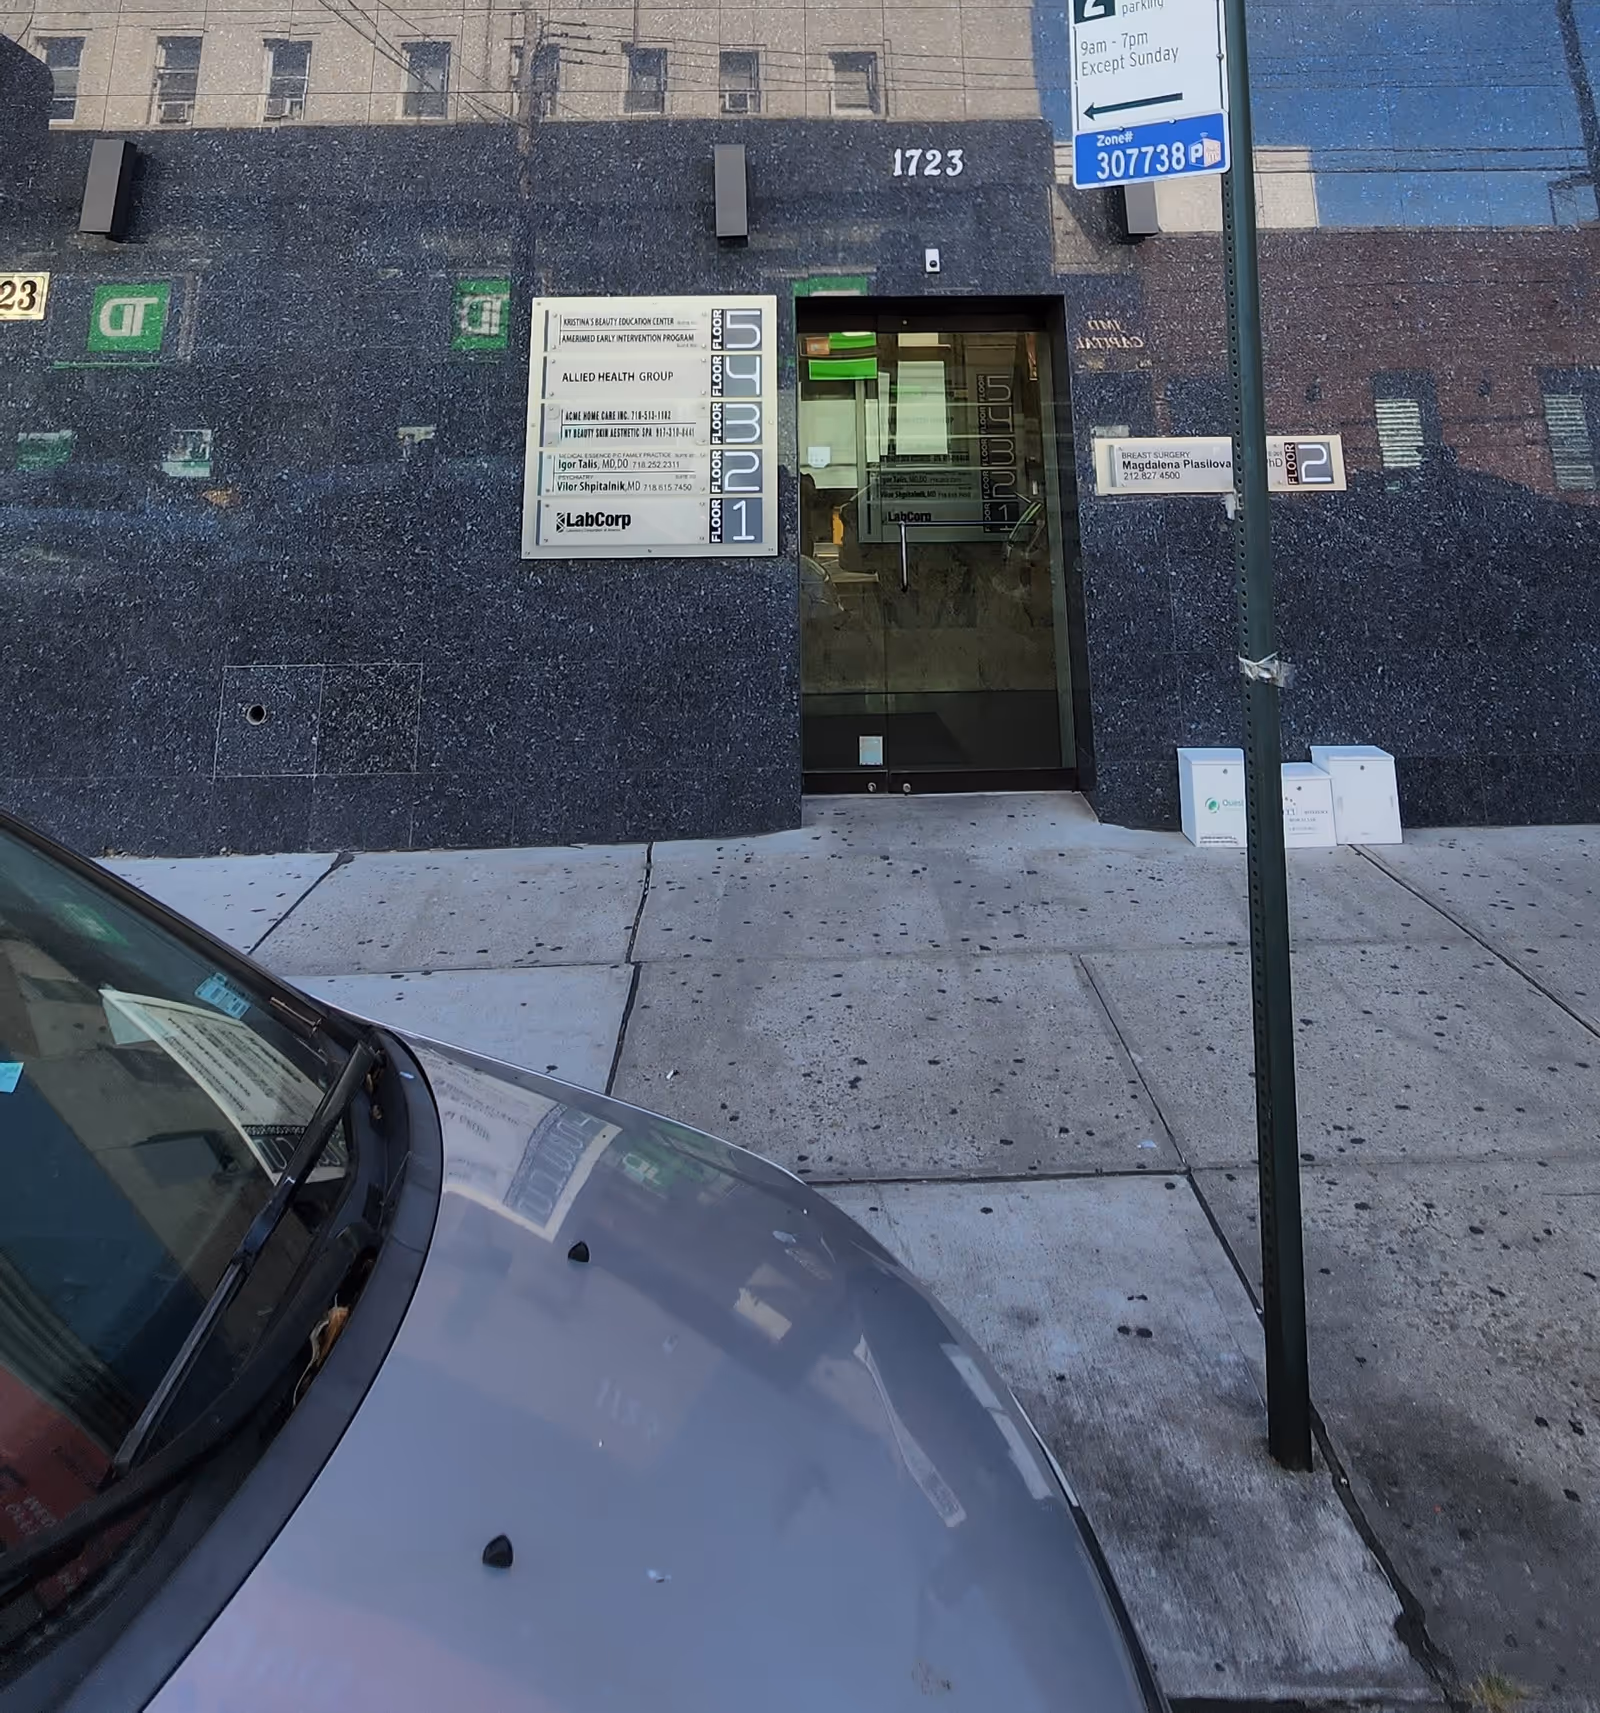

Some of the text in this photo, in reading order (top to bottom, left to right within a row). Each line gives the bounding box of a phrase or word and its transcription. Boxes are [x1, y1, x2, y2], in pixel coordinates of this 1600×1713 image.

[1081, 40, 1107, 56] 9am
[1121, 32, 1148, 52] 7pm
[1082, 46, 1179, 77] Except Sunday
[1096, 131, 1133, 147] Zone#
[893, 148, 964, 177] 1723
[1097, 141, 1186, 180] 307738
[595, 317, 617, 327] BEAUTY
[618, 317, 652, 326] EDUCATION
[652, 317, 675, 326] CENTER
[712, 309, 723, 351] FLOOR
[725, 310, 761, 349] 5
[561, 333, 695, 343] AMERIMED EARLY INTERVENTION PROGRAM
[562, 371, 674, 382] ALLIED HEALTH GROUP
[712, 356, 723, 397] FLOOR
[725, 356, 761, 396] 4
[565, 411, 581, 421] ACME
[583, 410, 599, 420] HOME
[601, 410, 616, 420] CARE
[618, 410, 630, 420] INC.
[711, 402, 723, 444] FLOOR
[725, 403, 761, 443] 3
[573, 428, 594, 438] BEAUTY
[610, 428, 640, 438] AESTHETIC
[642, 427, 652, 437] SPA
[559, 459, 576, 471] Igor
[578, 459, 600, 470] Talis,
[1122, 450, 1190, 459] BREAST SURGERY
[1122, 460, 1182, 471] Magdalena
[1286, 443, 1298, 484] FLOOR
[1298, 444, 1332, 483] 2
[557, 481, 578, 491] Vilor
[711, 450, 723, 493] FLOOR
[724, 451, 760, 491] 2
[566, 511, 632, 530] LabCorp
[711, 499, 723, 543] FLOOR
[732, 500, 755, 540] 1
